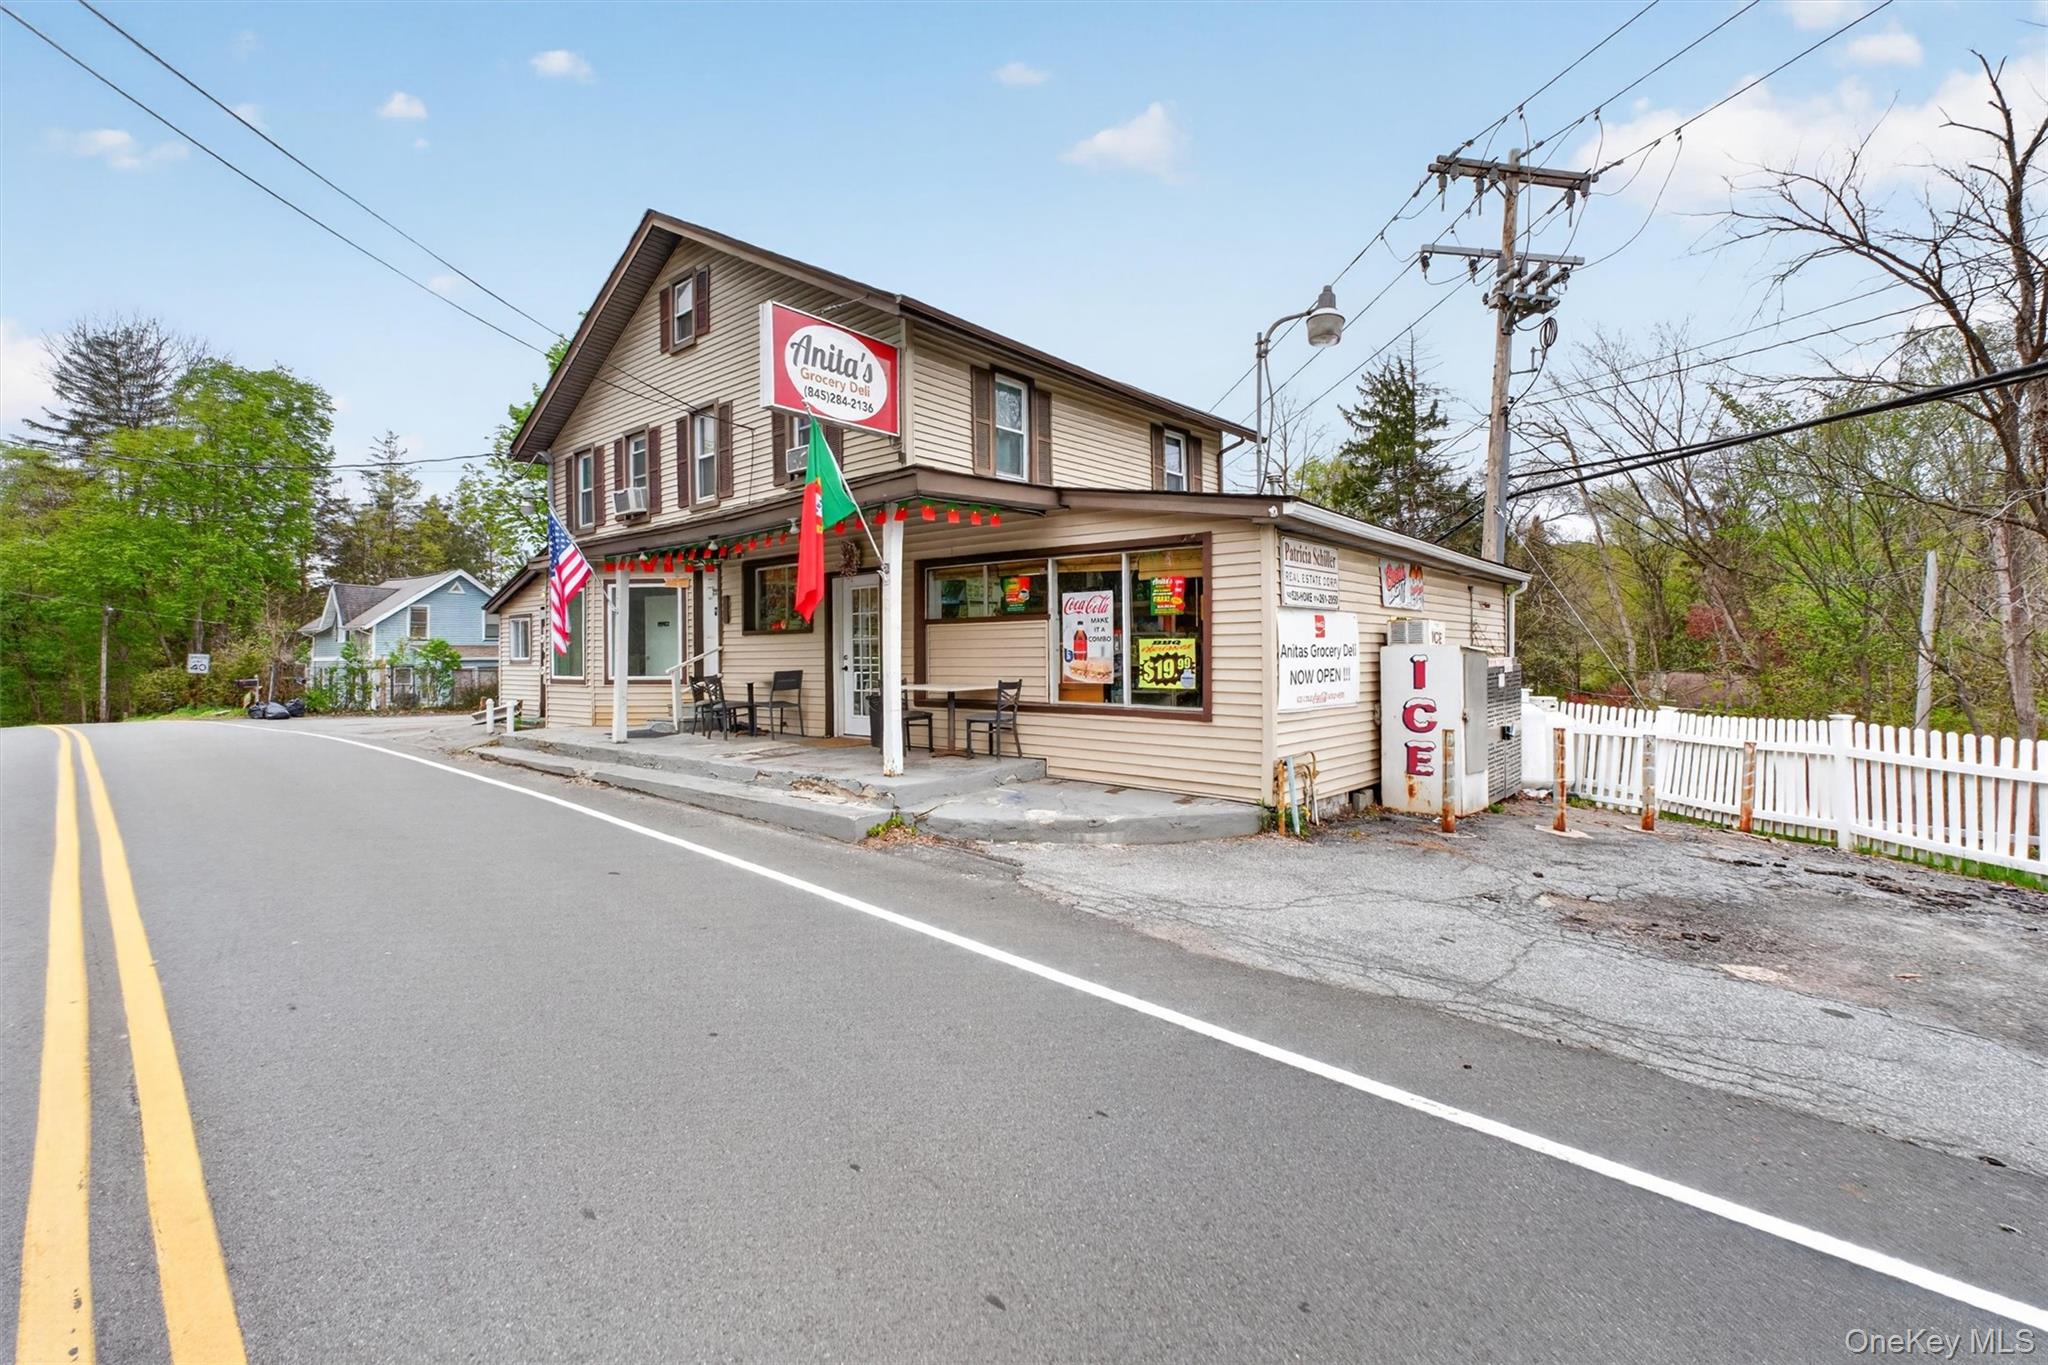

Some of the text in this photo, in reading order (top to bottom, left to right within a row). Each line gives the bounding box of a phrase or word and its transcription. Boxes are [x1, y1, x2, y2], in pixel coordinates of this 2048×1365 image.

[790, 334, 873, 384] Anita's
[800, 367, 871, 398] Grocery Deli
[803, 385, 875, 414] (845)284-2136
[1284, 542, 1312, 565] Patricia
[1285, 570, 1300, 583] REAL
[1301, 573, 1322, 586] ESTATE
[1090, 616, 1110, 624] MAKE
[1088, 635, 1112, 643] COMBO
[1431, 630, 1443, 646] ICE
[1280, 643, 1357, 660] Anitas Grocery Deli
[190, 663, 207, 672] 40
[1289, 669, 1315, 686] NOW
[1316, 667, 1342, 684] OPEN
[1402, 653, 1438, 777] ICE
